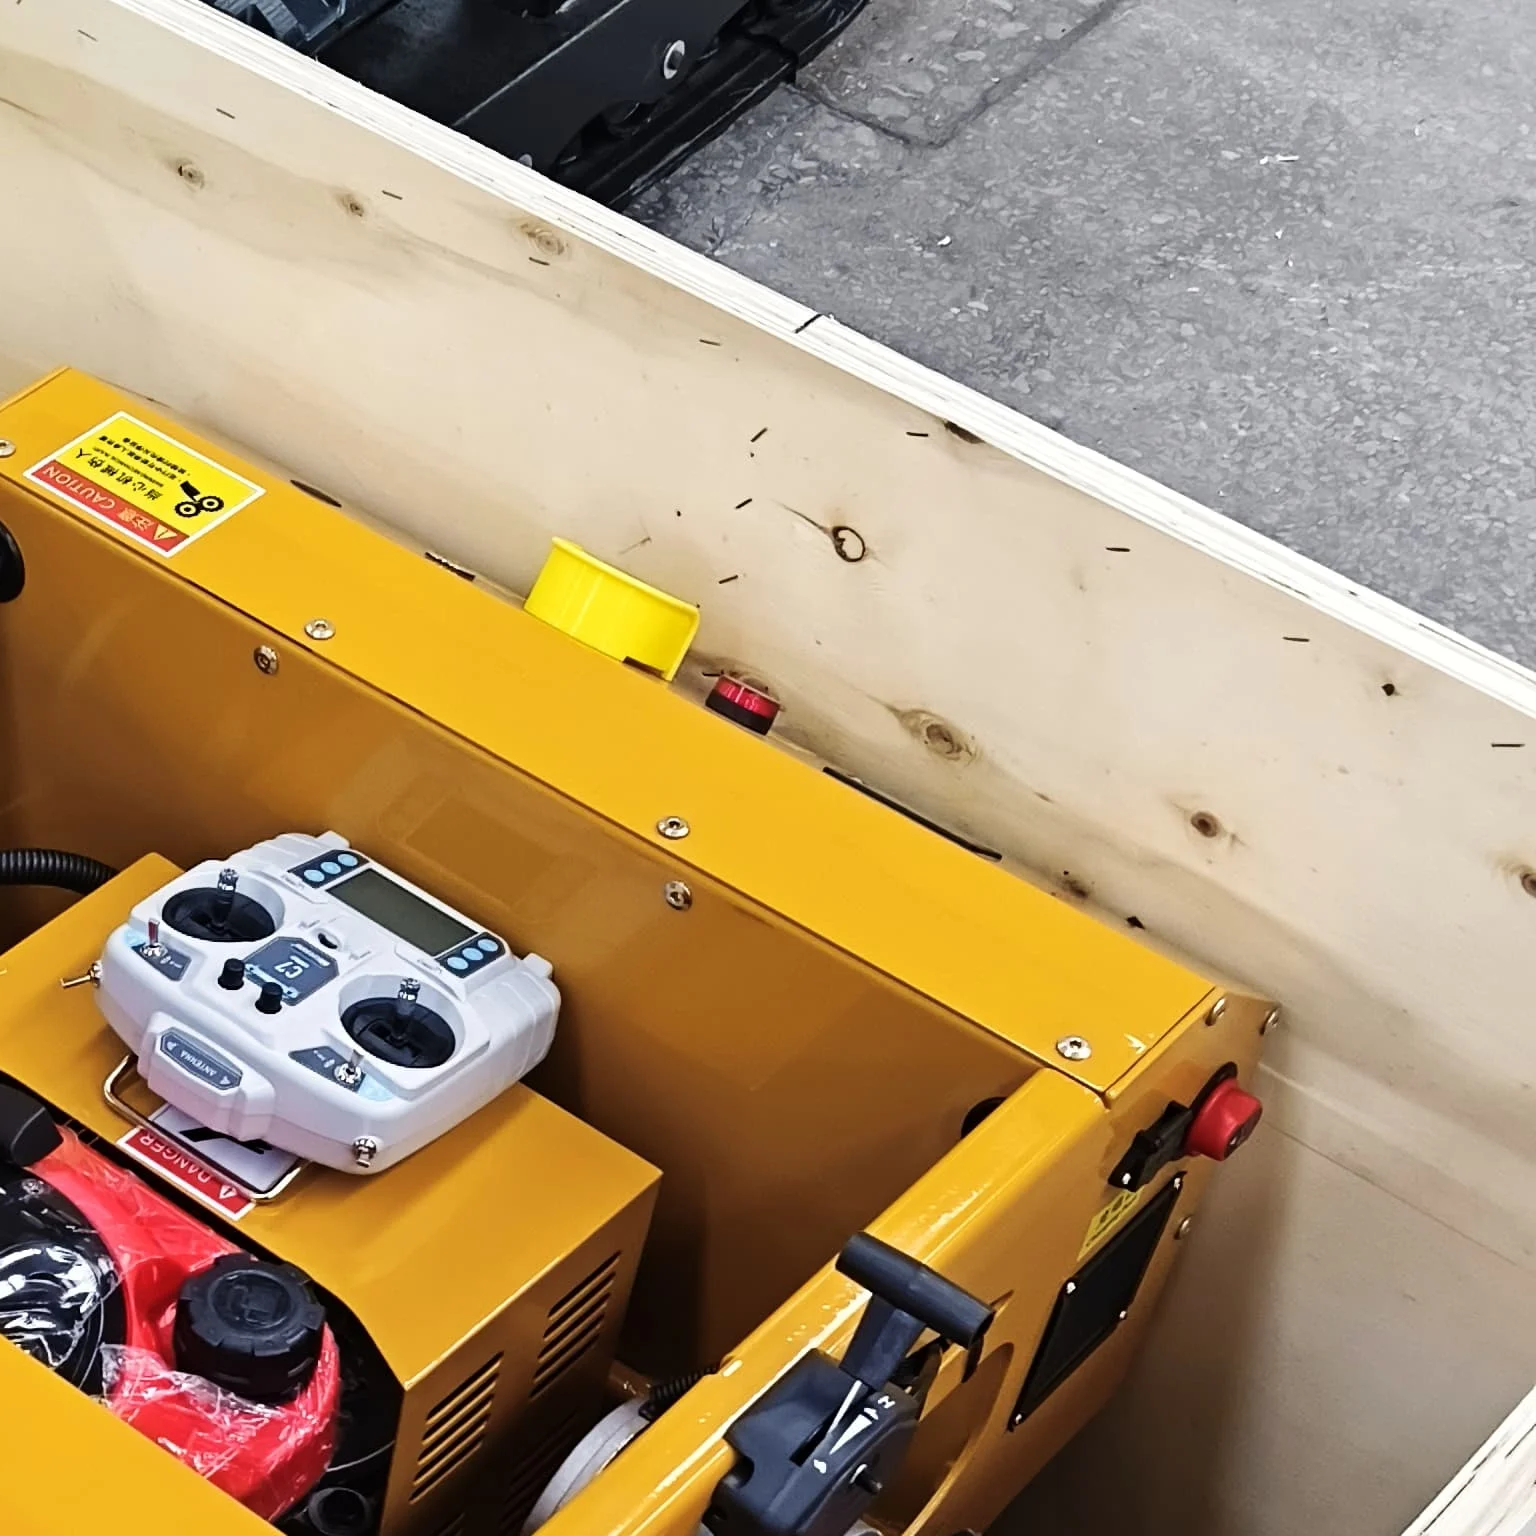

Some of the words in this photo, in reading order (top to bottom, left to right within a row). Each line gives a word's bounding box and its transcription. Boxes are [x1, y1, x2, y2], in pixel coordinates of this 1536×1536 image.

[43, 466, 117, 510] CAUTION
[179, 1050, 218, 1078] ANTENNA
[137, 1134, 212, 1185] DANGER
